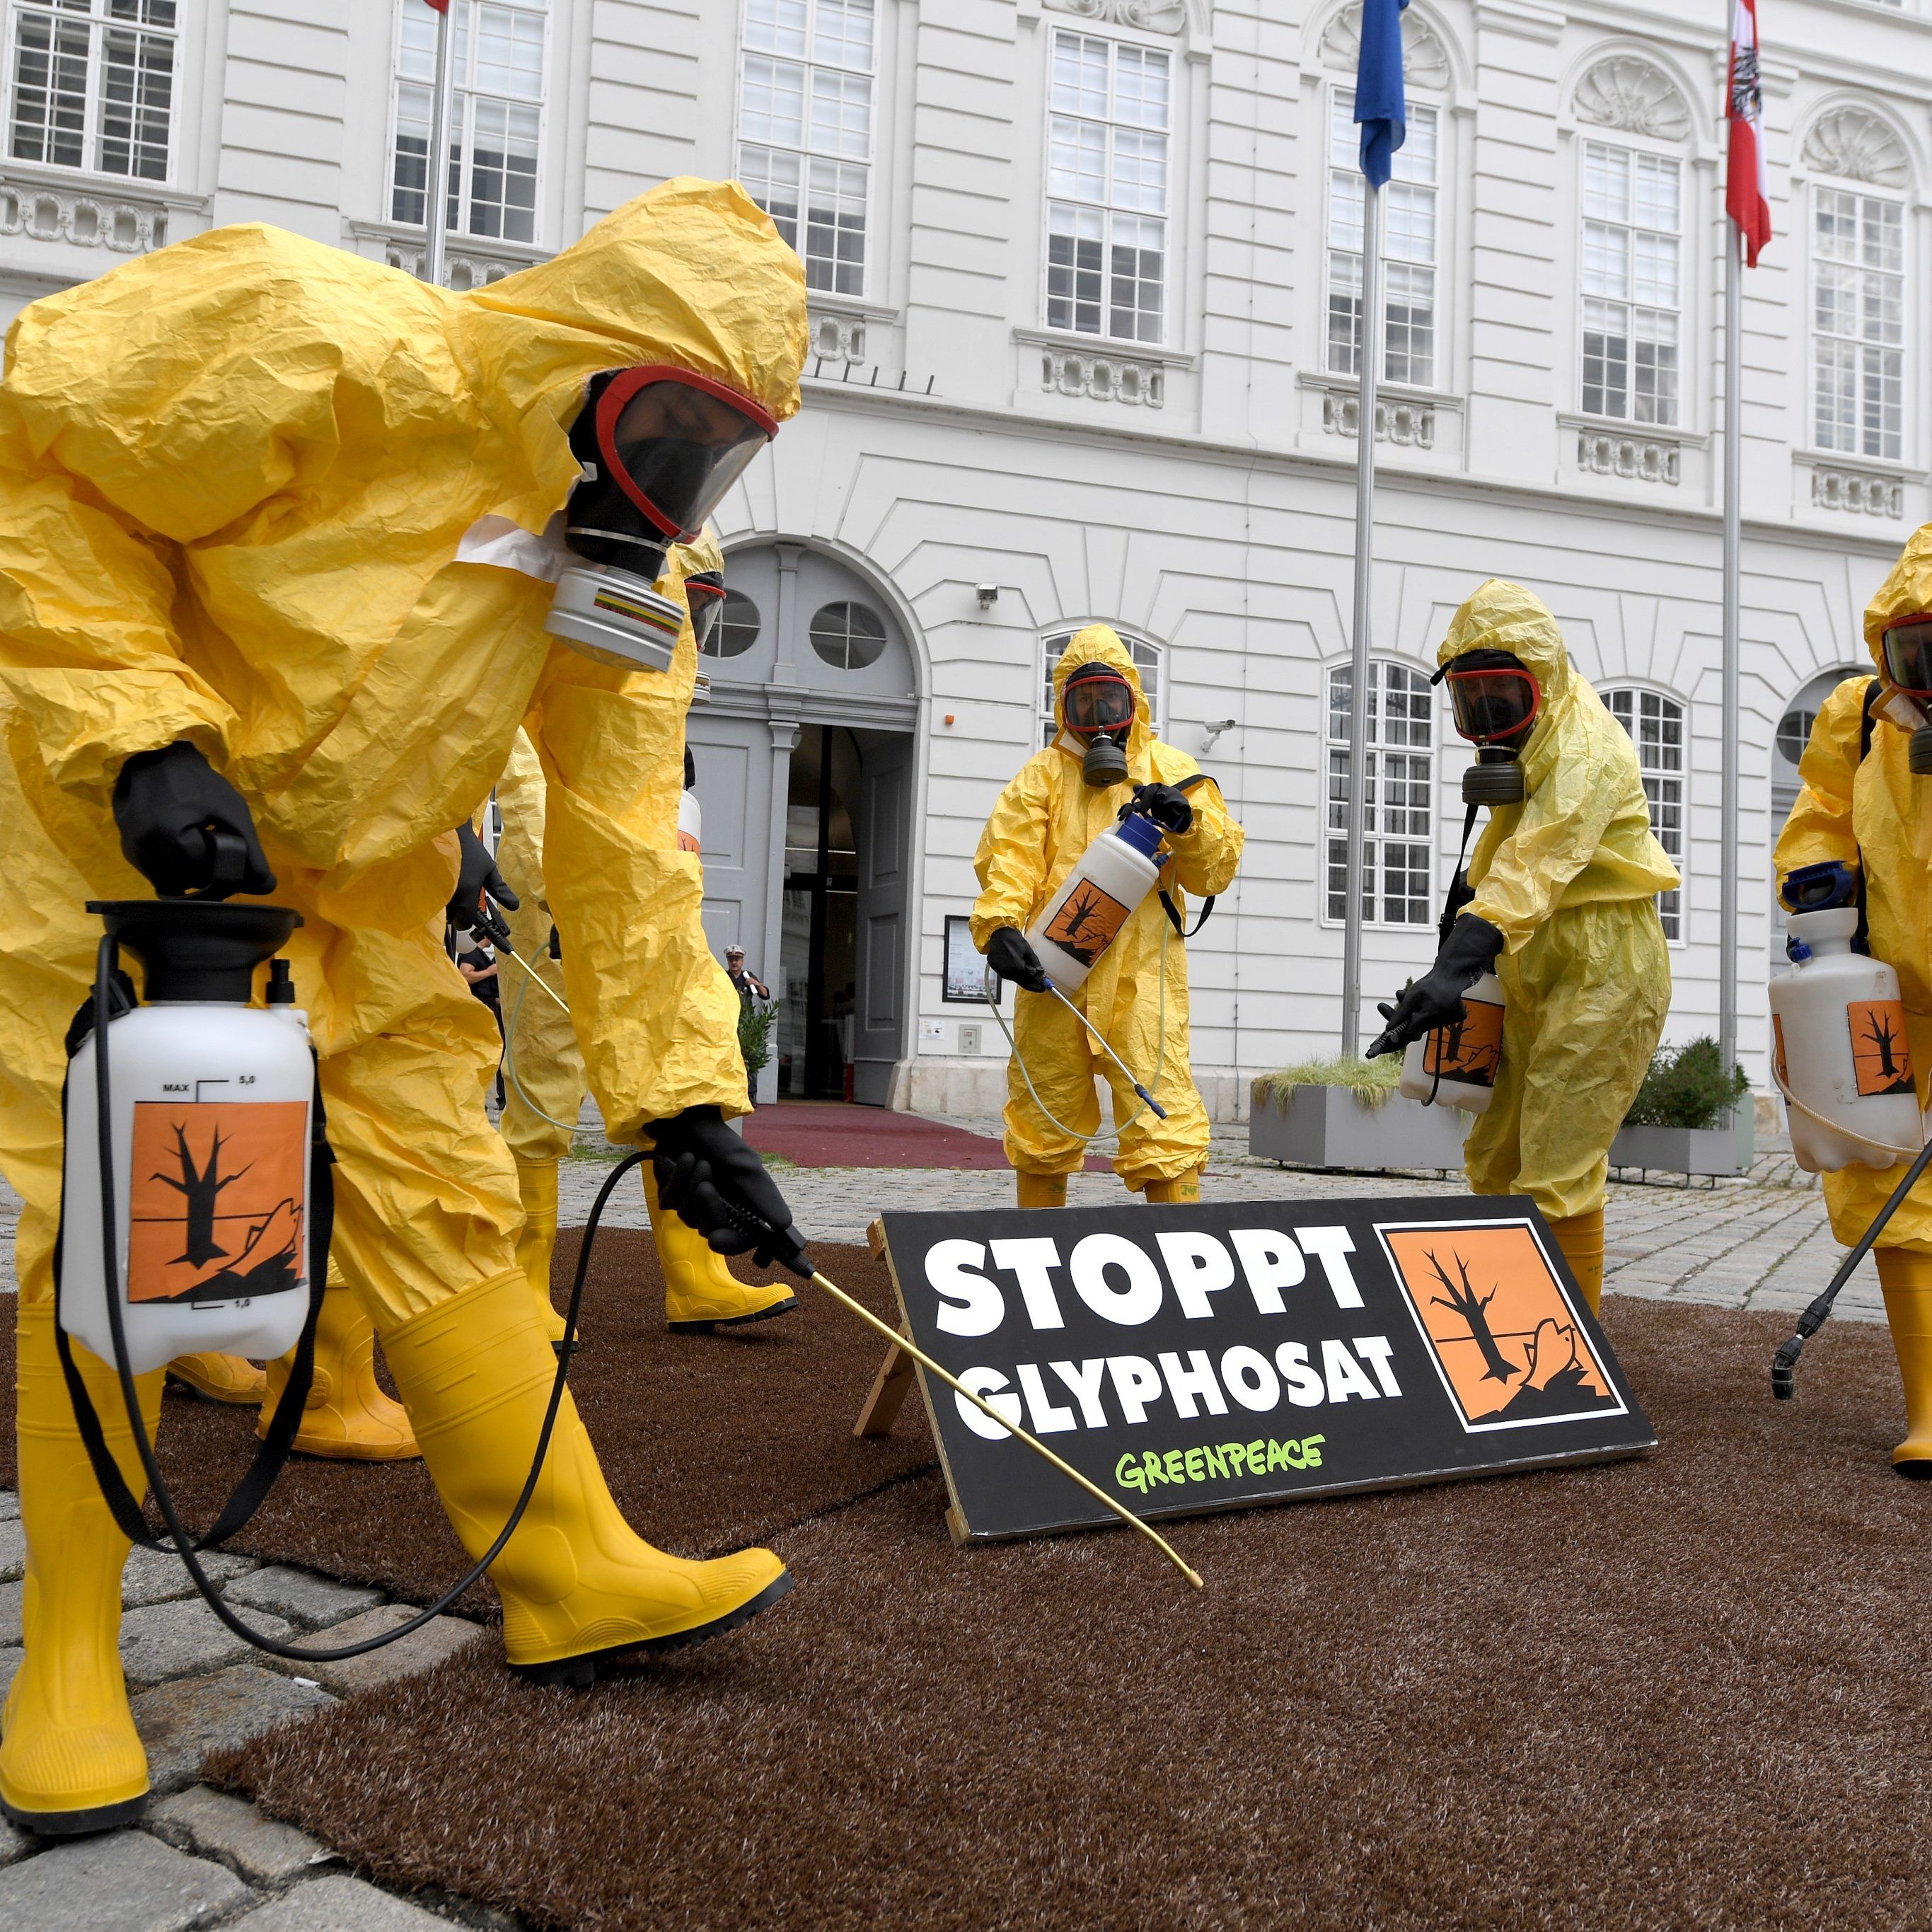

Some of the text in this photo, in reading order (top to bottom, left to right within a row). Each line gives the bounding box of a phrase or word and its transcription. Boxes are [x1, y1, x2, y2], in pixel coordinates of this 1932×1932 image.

[162, 1084, 190, 1092] MAX
[238, 1075, 255, 1085] 5,0
[924, 1225, 1365, 1337] STOPPT
[234, 1298, 251, 1309] 1,0
[954, 1336, 1403, 1440] GLYPHOSAT
[1114, 1433, 1326, 1494] GREENPEACE
